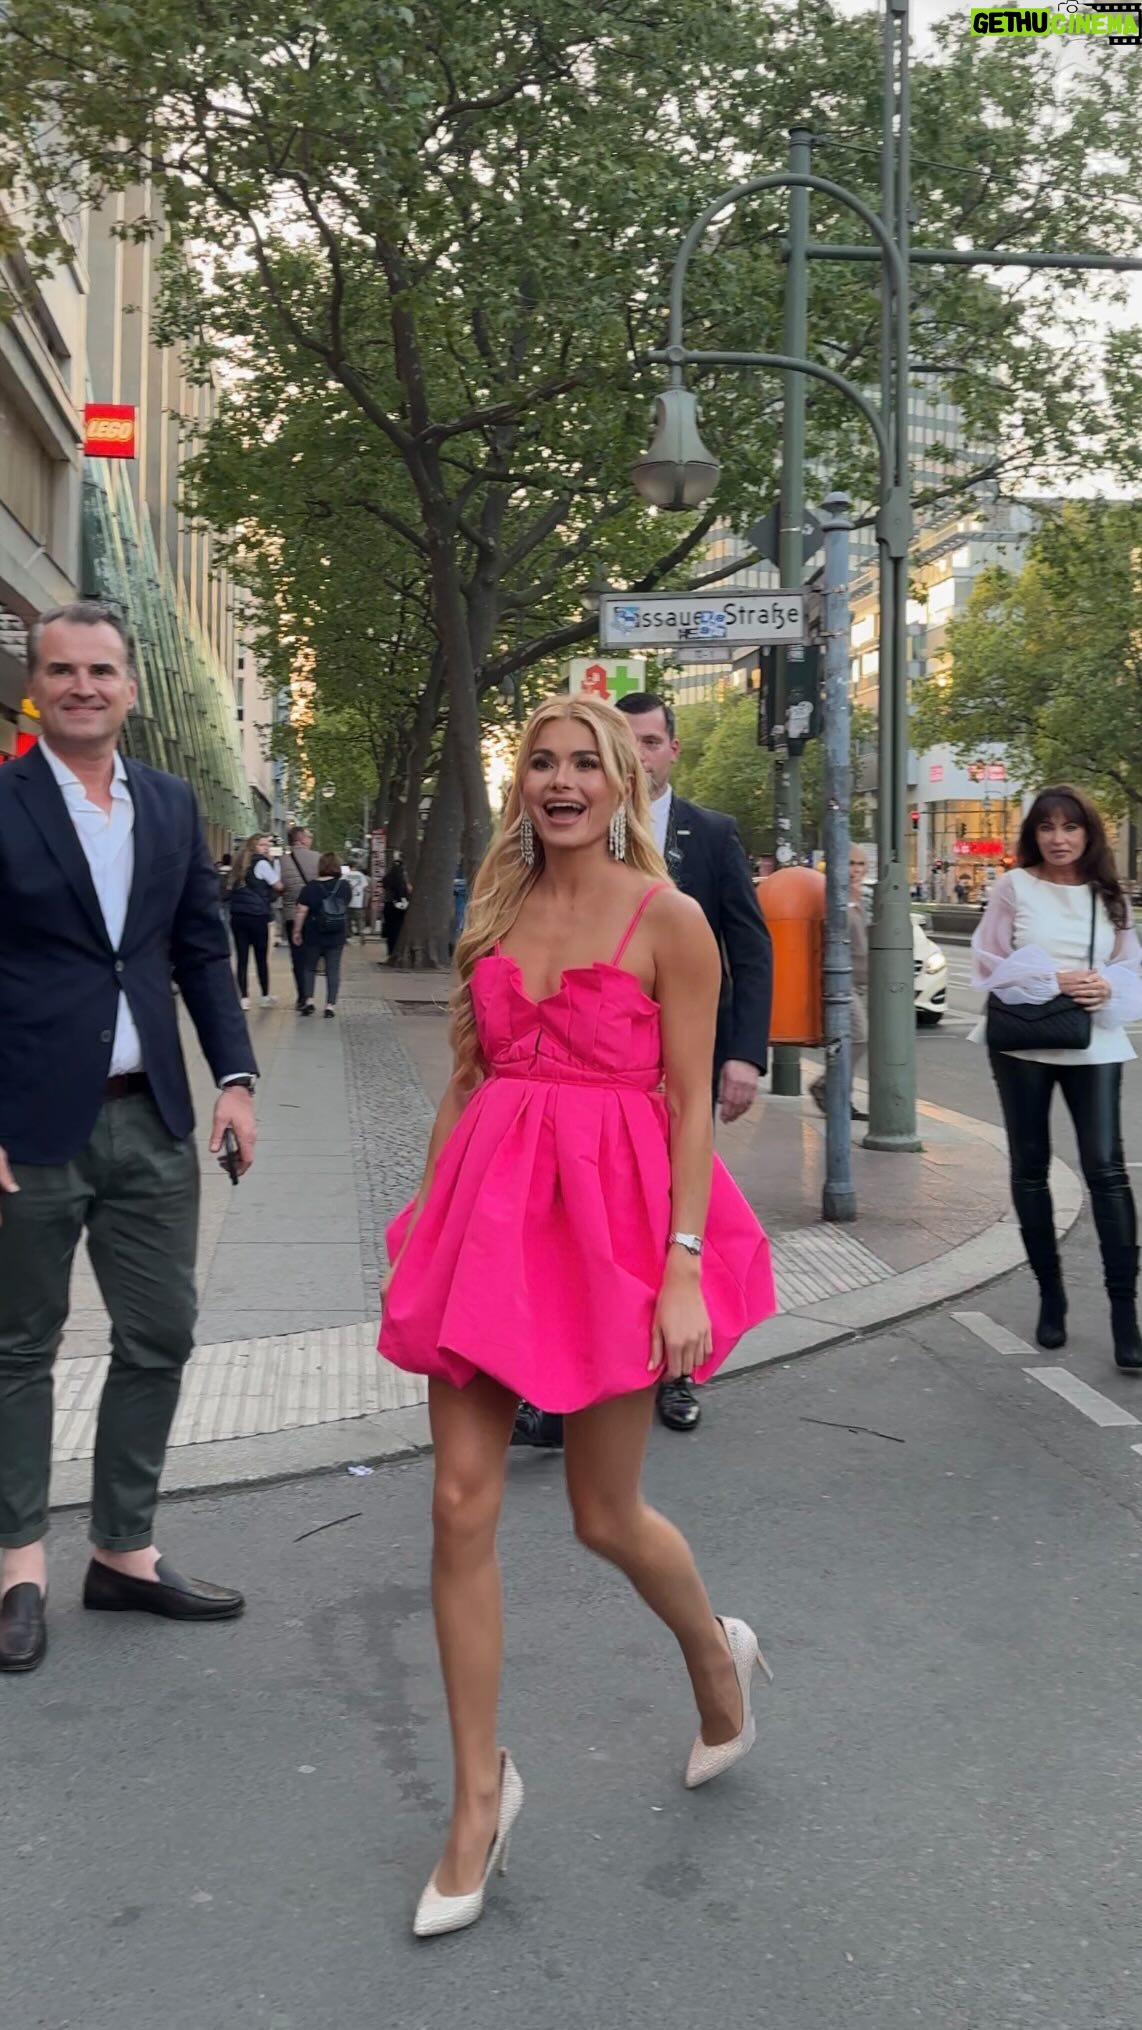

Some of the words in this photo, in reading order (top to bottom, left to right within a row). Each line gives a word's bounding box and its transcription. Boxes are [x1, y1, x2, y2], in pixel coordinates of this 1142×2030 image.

[87, 419, 132, 441] LEGO
[614, 606, 703, 628] ssaue
[723, 602, 799, 629] Straße
